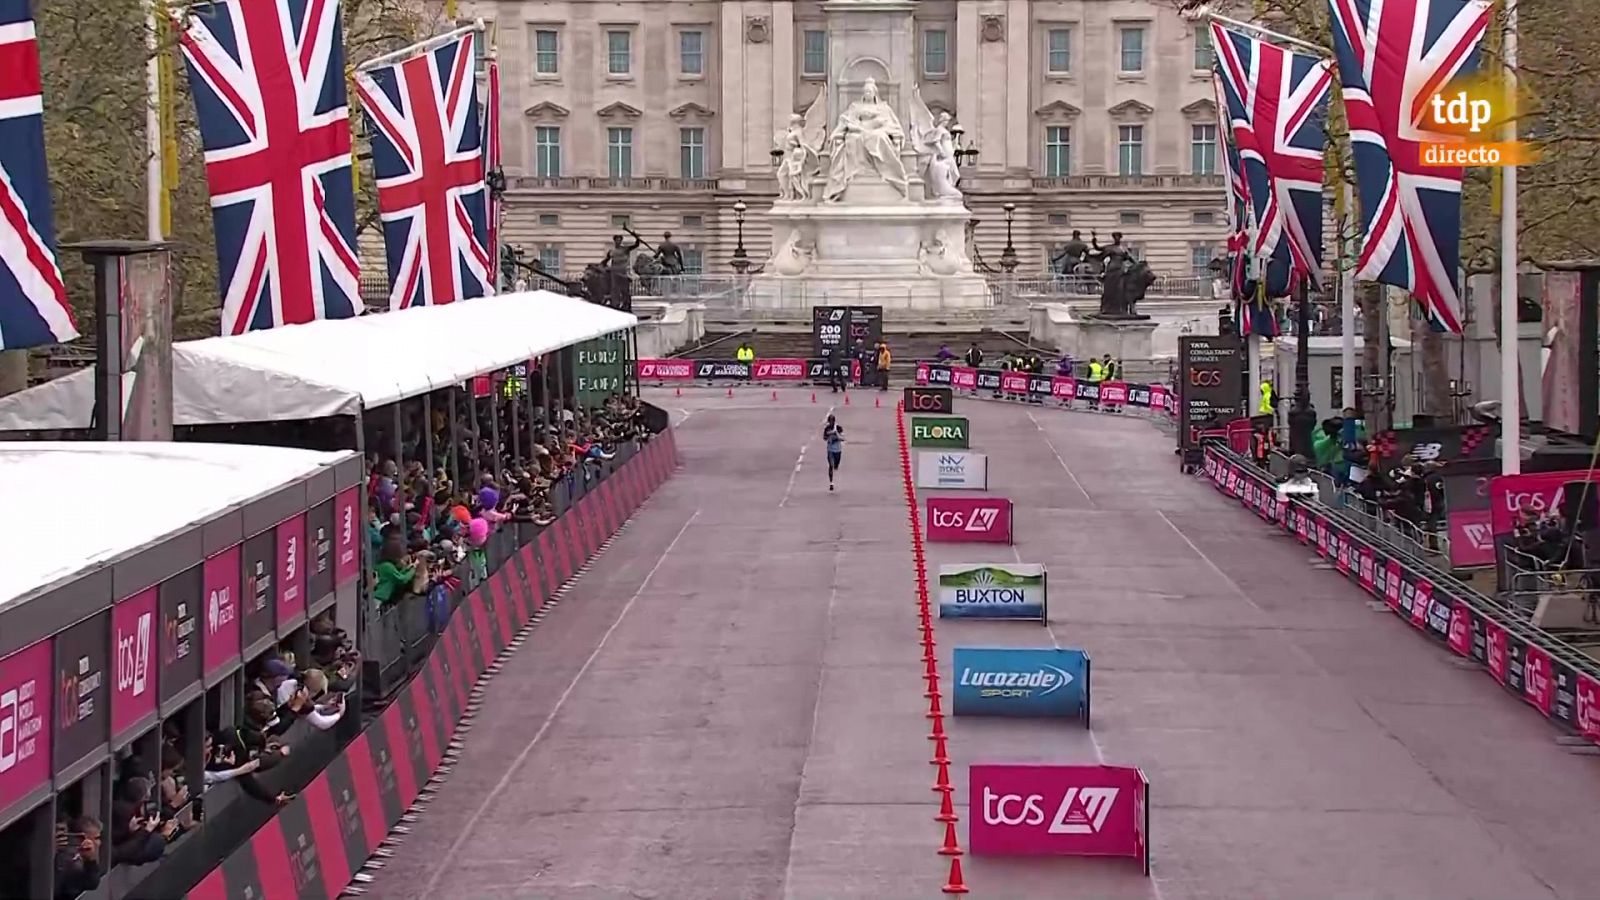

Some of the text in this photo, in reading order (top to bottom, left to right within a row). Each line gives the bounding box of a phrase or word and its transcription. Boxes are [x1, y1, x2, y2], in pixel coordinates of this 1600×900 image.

[820, 325, 841, 334] 200
[1190, 367, 1221, 386] tcs
[912, 390, 942, 410] tcs
[914, 426, 963, 438] FLORA
[933, 507, 963, 527] tcs
[956, 589, 1024, 603] BUXTON
[118, 628, 134, 692] tcs
[960, 667, 1056, 687] Lucozade
[980, 689, 1032, 697] SPORT
[983, 786, 1044, 825] tcs
